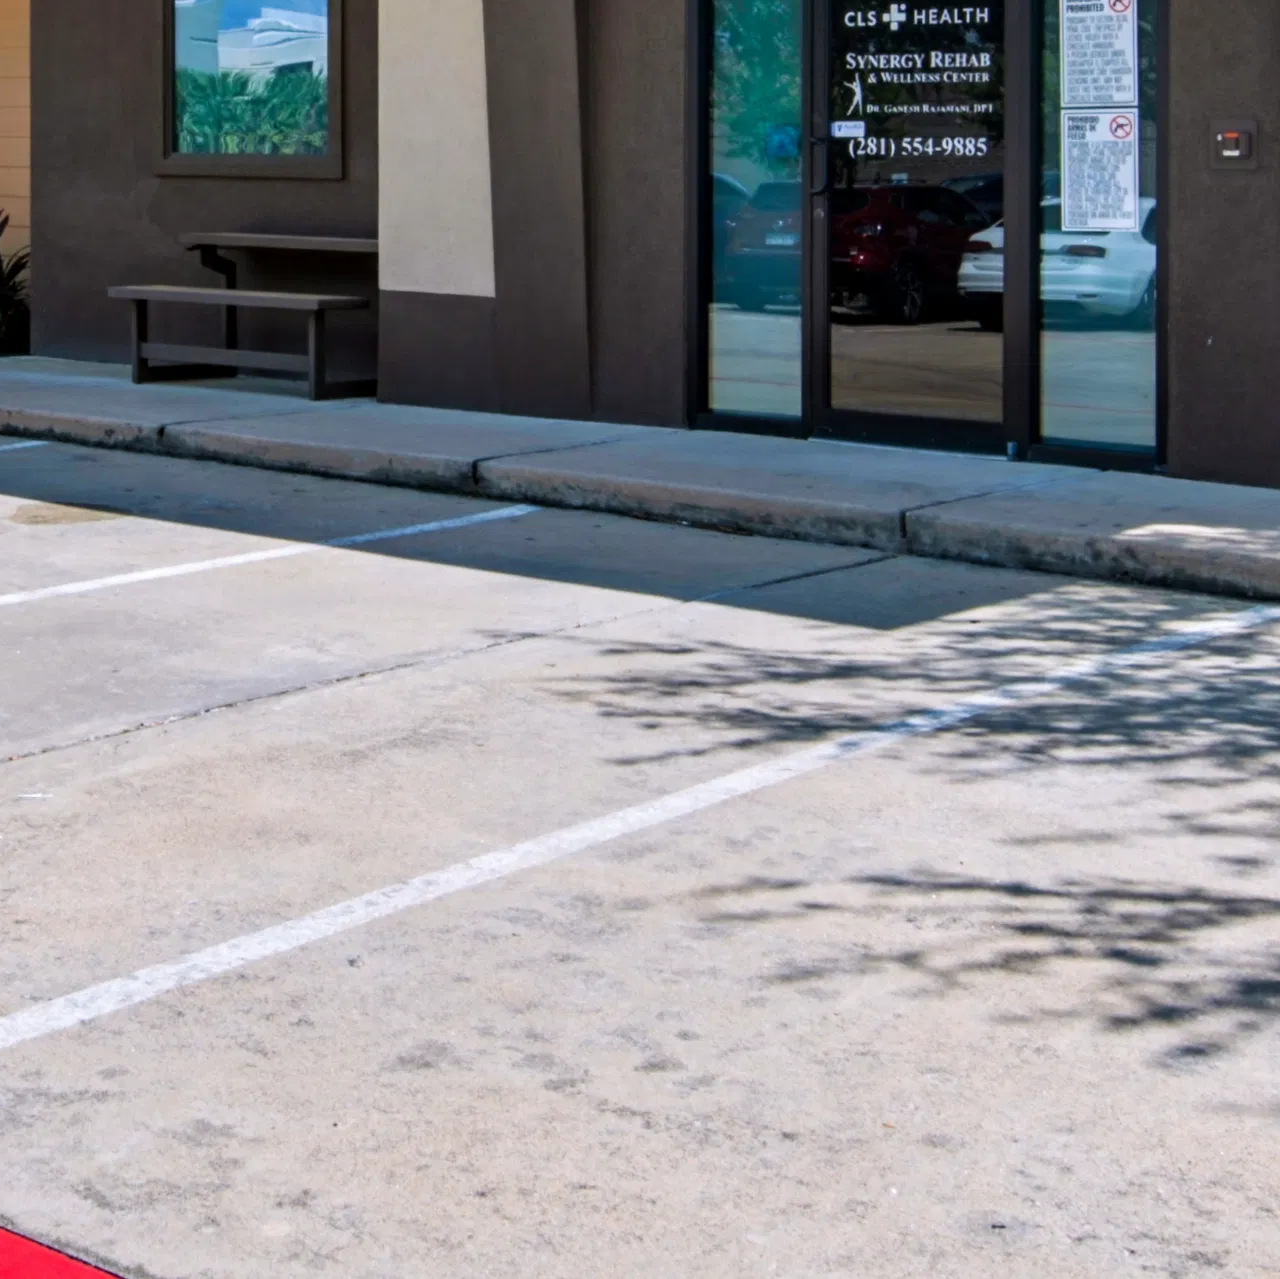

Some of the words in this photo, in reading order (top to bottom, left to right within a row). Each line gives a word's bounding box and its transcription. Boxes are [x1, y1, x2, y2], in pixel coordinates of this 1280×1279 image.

[844, 10, 877, 27] CLS
[913, 7, 989, 25] HEALTH
[845, 52, 925, 70] SYNERGY
[930, 51, 992, 68] REHAB
[867, 73, 877, 84] &
[881, 72, 941, 84] WELLNESS
[943, 71, 990, 83] CENTER
[848, 138, 896, 159] (281)
[901, 137, 988, 157] 554-9885
